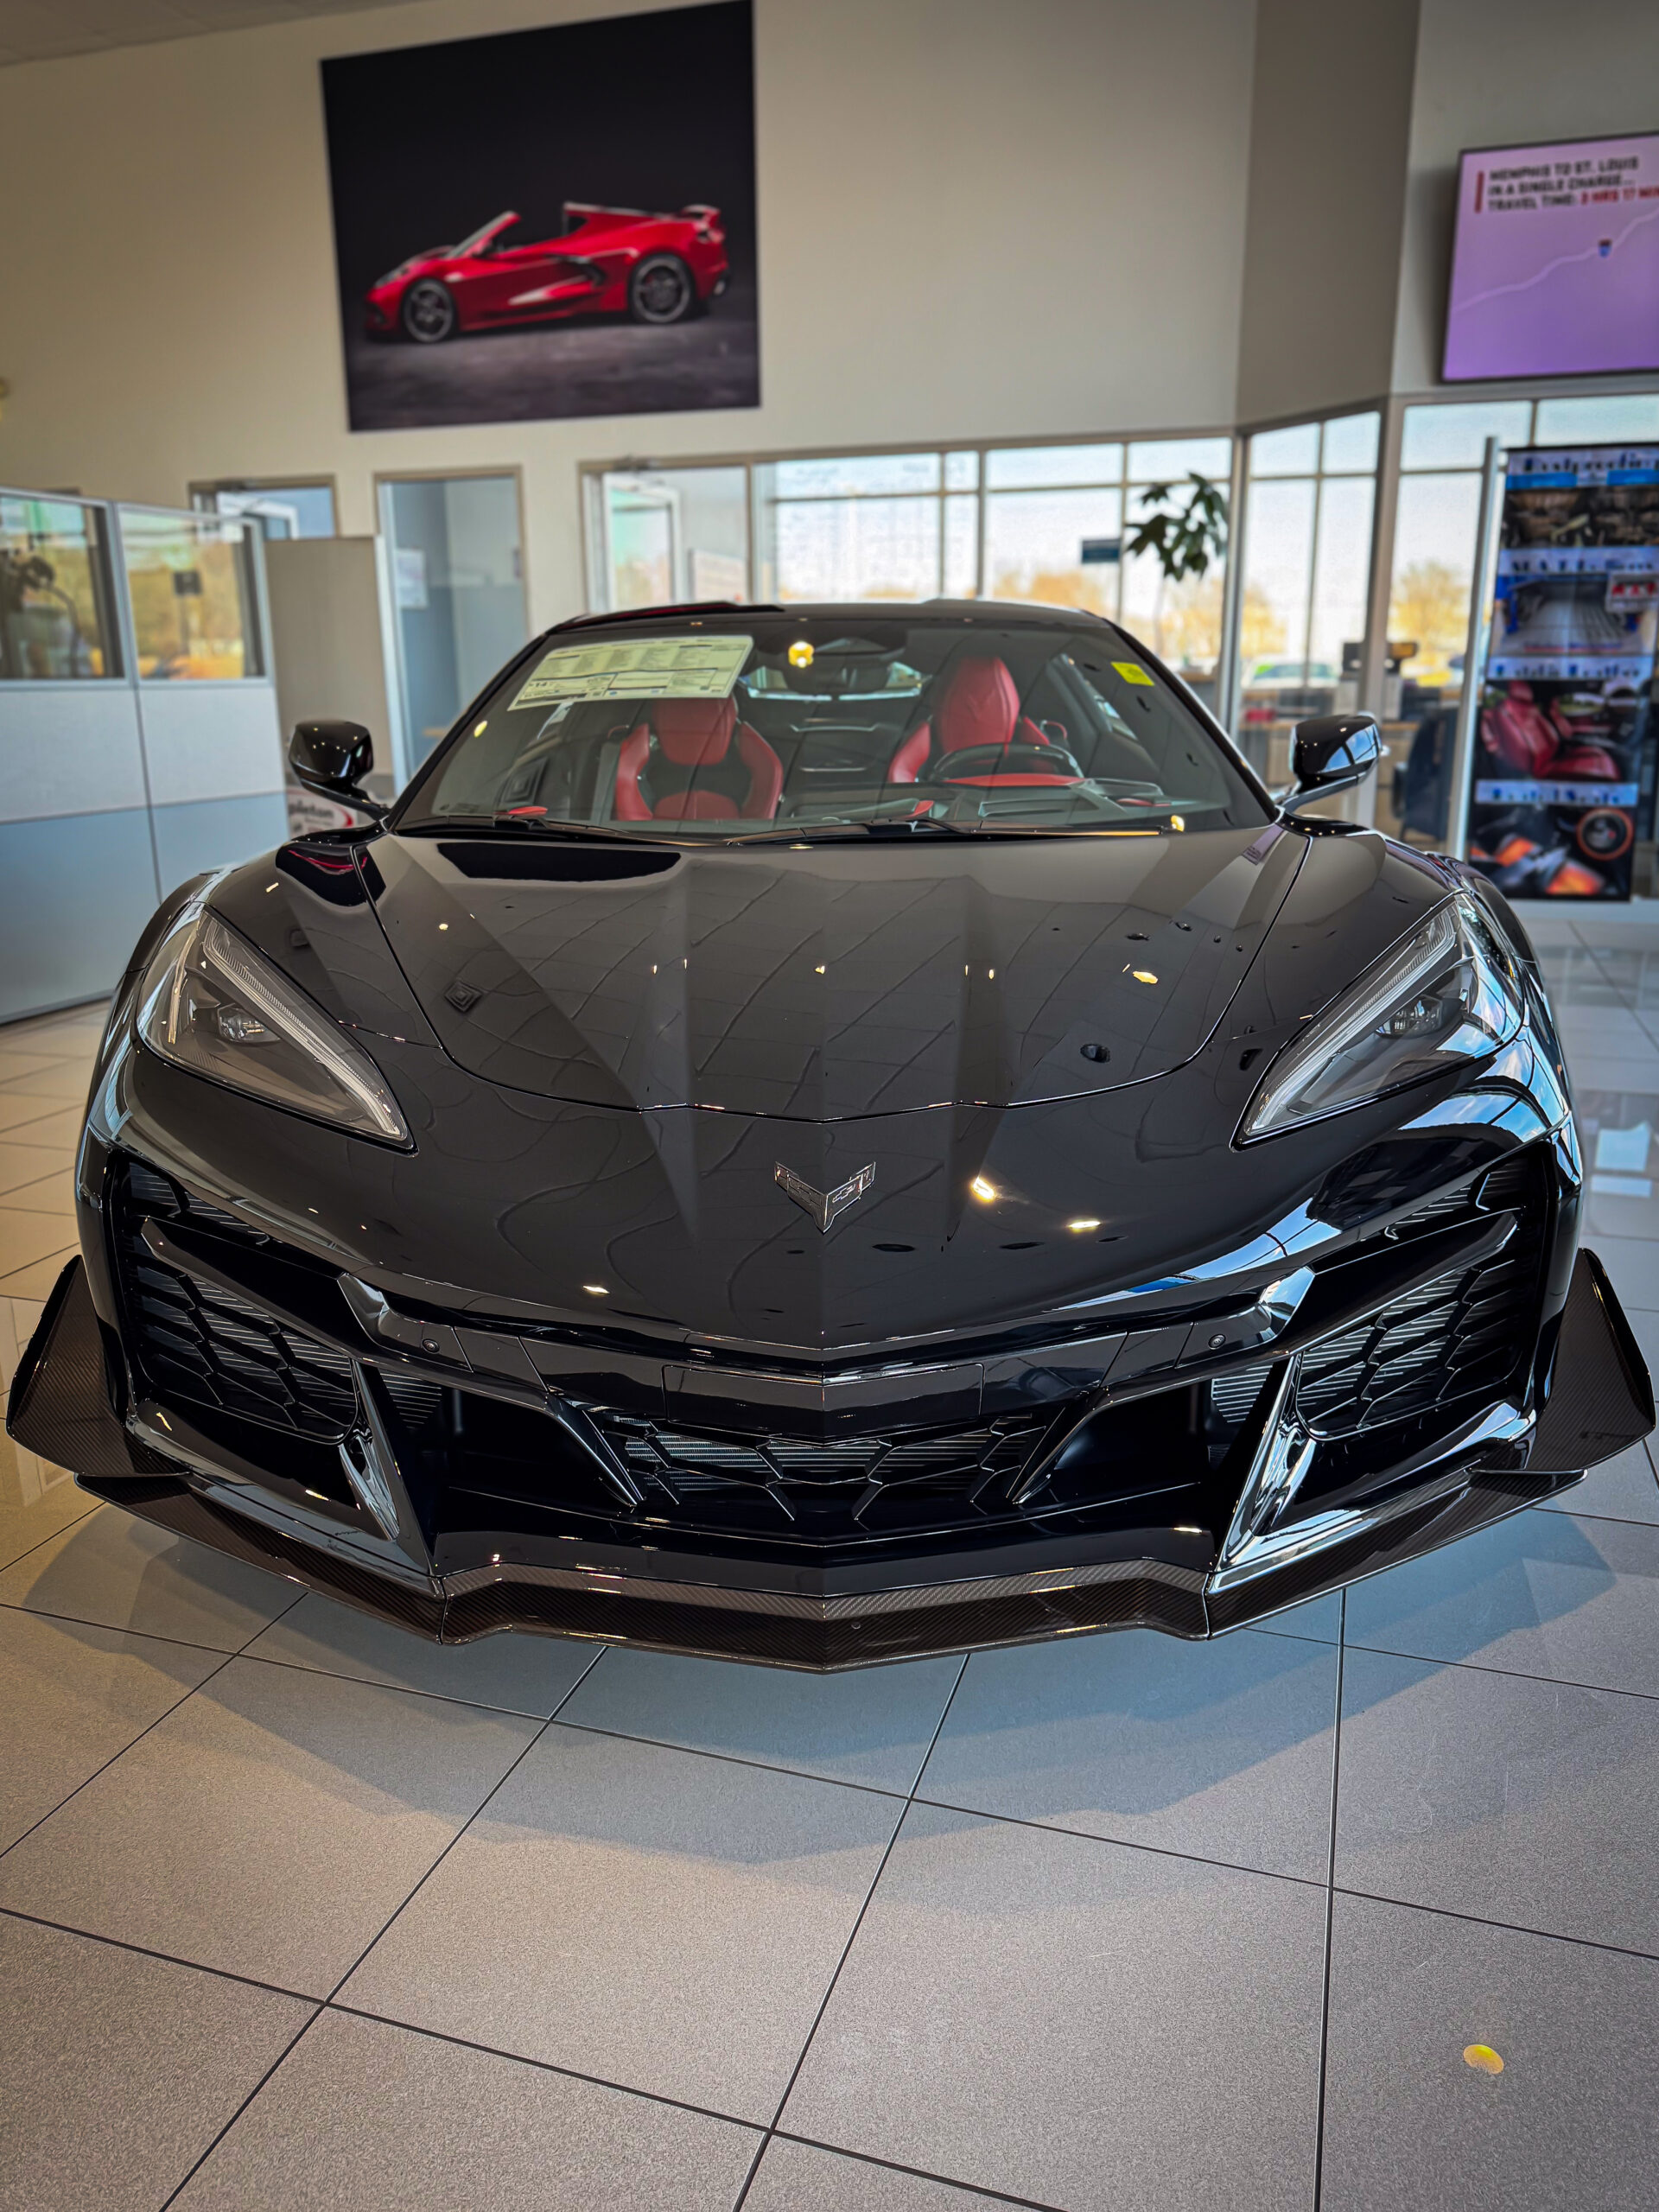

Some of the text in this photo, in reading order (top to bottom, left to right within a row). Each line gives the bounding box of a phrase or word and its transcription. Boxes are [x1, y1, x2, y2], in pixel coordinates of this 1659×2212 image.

[1490, 164, 1551, 180] MEMPHIS
[1554, 162, 1572, 175] TO
[1599, 156, 1638, 171] LOUIS
[1487, 184, 1503, 196] IN
[1505, 183, 1516, 195] A
[1518, 179, 1564, 194] SINGLE
[1488, 198, 1537, 211] TRAVEL
